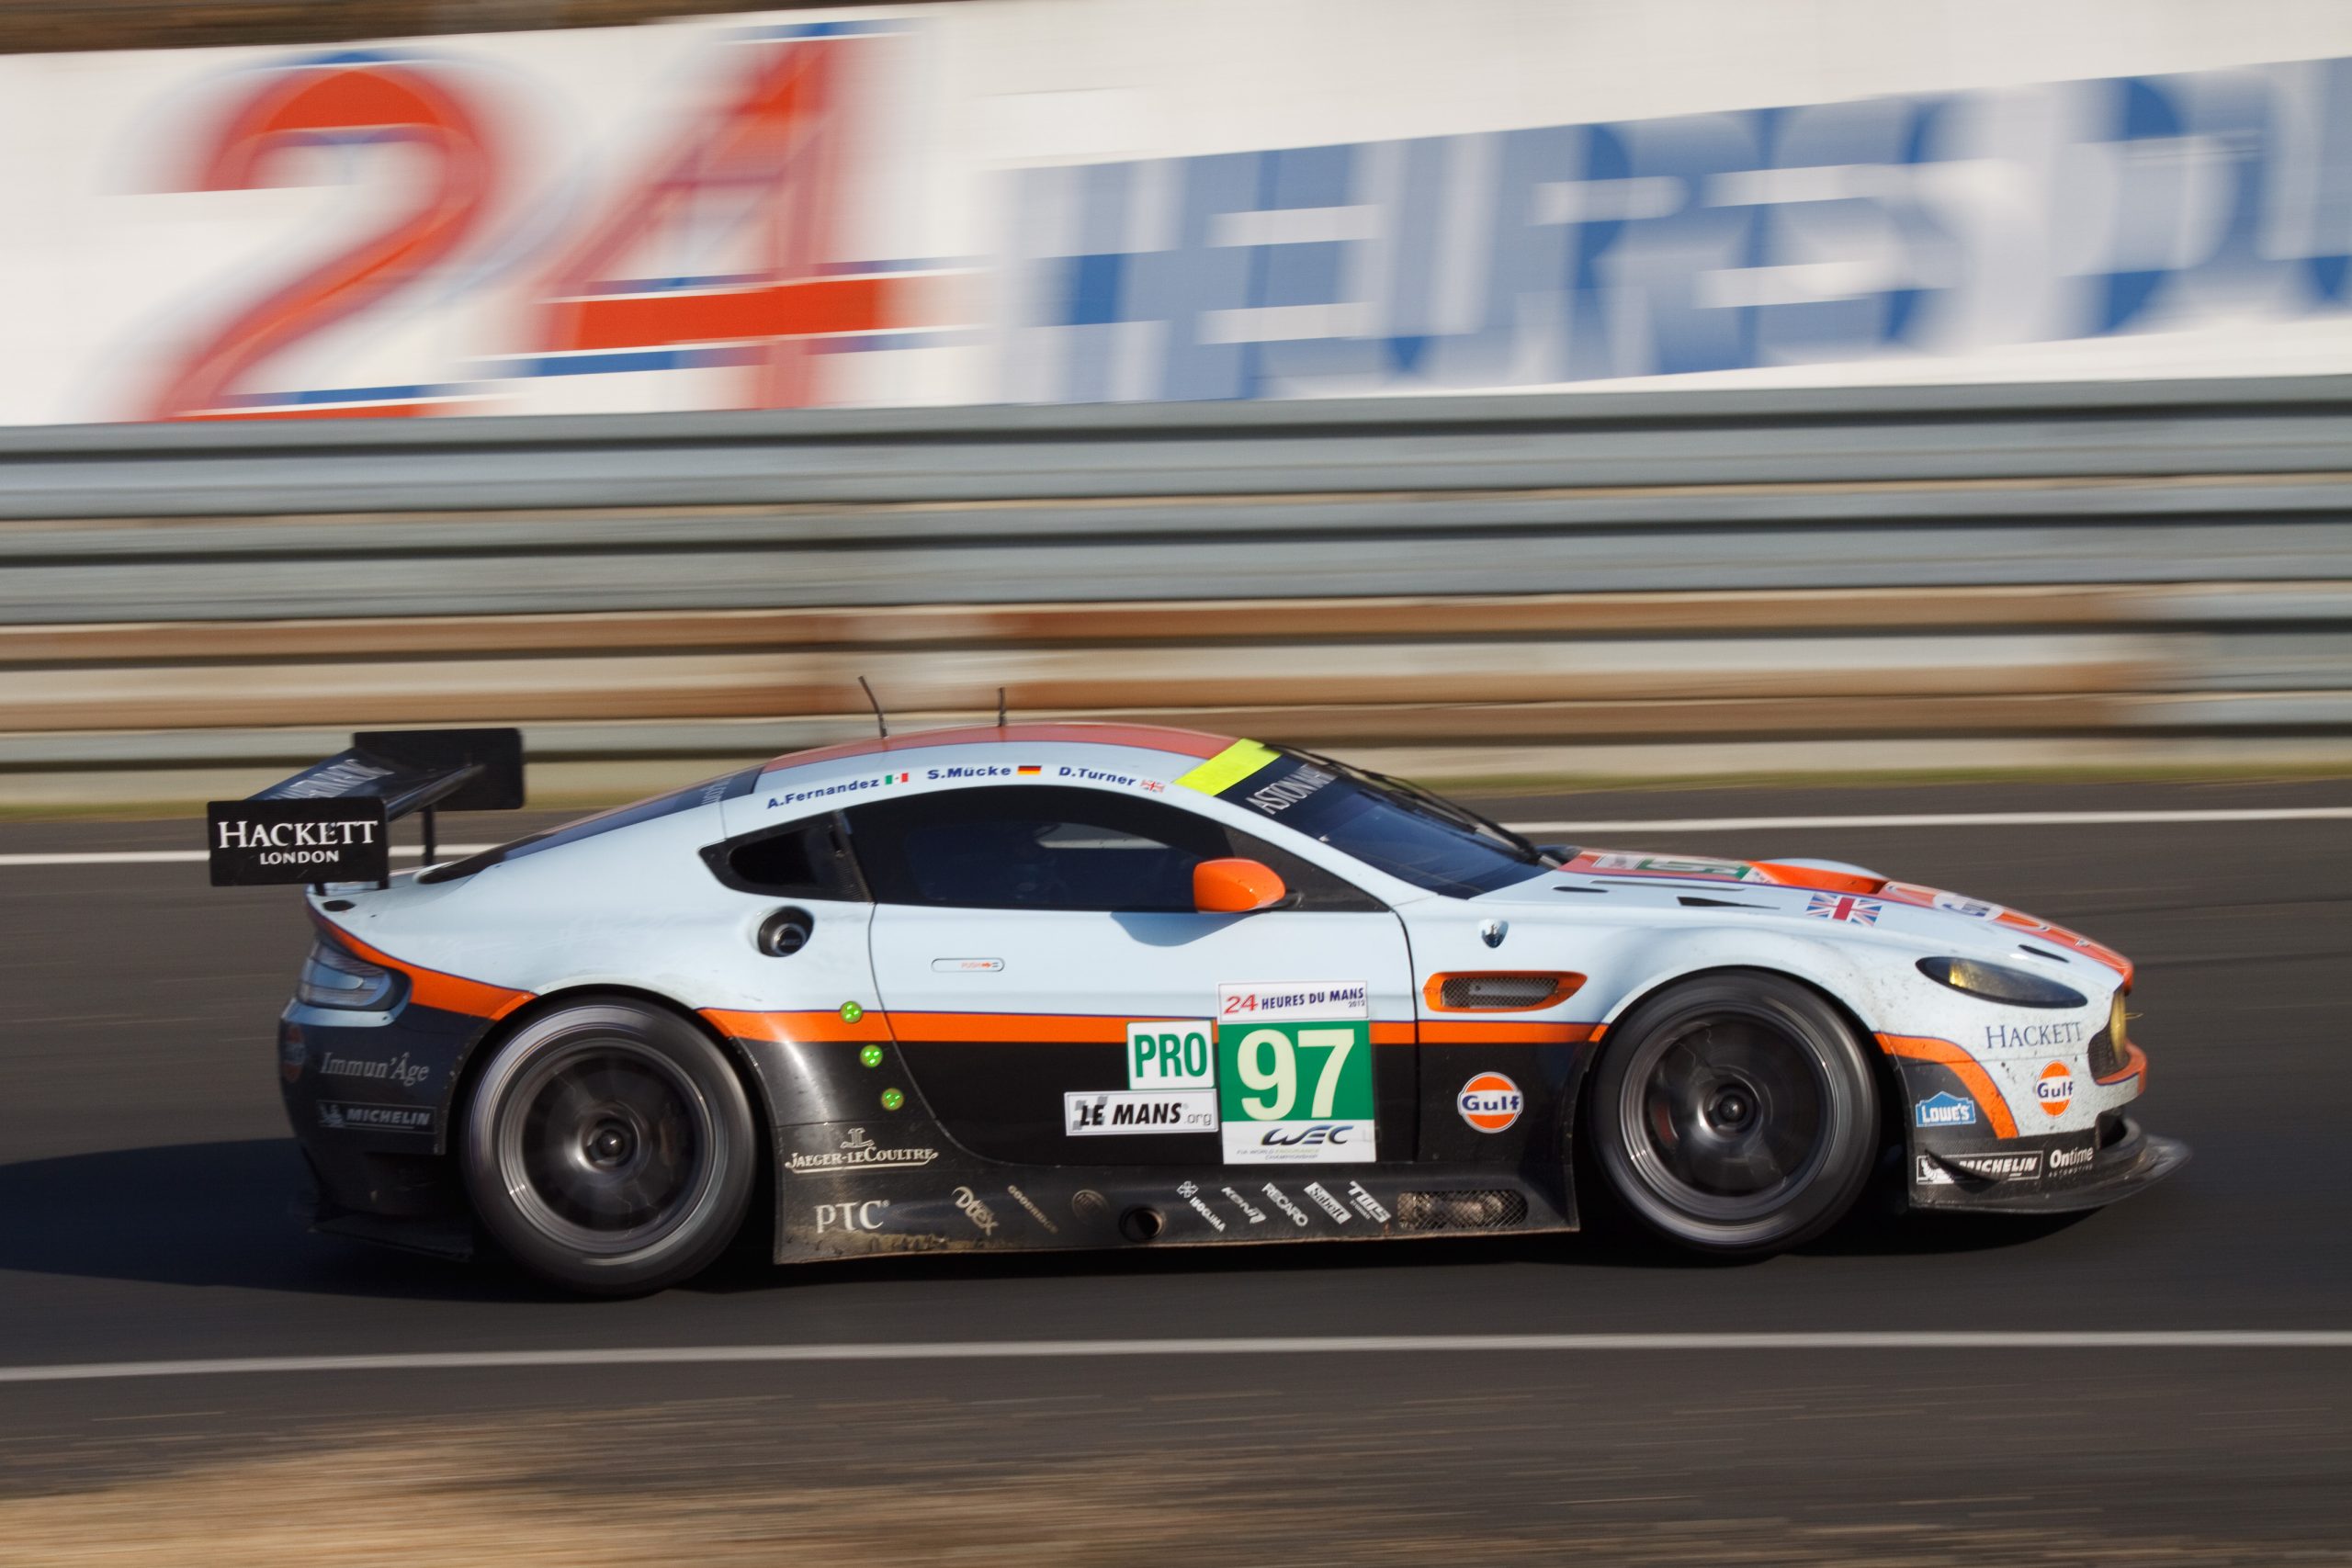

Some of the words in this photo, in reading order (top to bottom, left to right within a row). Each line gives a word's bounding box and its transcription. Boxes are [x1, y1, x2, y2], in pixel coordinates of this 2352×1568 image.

[927, 764, 1012, 780] S.Mücke
[1058, 766, 1136, 785] D.Turner
[767, 779, 879, 808] A.Fernandez
[218, 819, 378, 848] HACKETT
[260, 850, 339, 864] LONDON
[1224, 994, 1258, 1014] 24
[1261, 994, 1305, 1010] HEURES
[1309, 992, 1325, 1003] DU
[1330, 987, 1363, 1001] MANS
[1985, 1021, 2082, 1049] HACKETT
[1135, 1032, 1207, 1078] PRO
[1238, 1029, 1354, 1121] 97
[2037, 1082, 2073, 1098] Gulf
[1080, 1104, 1102, 1126] LE
[1112, 1102, 1182, 1125] MANS
[1462, 1095, 1521, 1111] Gulf
[1922, 1103, 1971, 1122] LOWE'S
[346, 1109, 430, 1126] MICHELIN
[1261, 1125, 1354, 1146] WEC
[2050, 1147, 2094, 1168] Ontime
[1190, 1197, 1226, 1233] ISOCLIMA
[1261, 1182, 1308, 1227] RECARO
[1309, 1186, 1346, 1220] Sabelt
[815, 1201, 883, 1233] PTC
